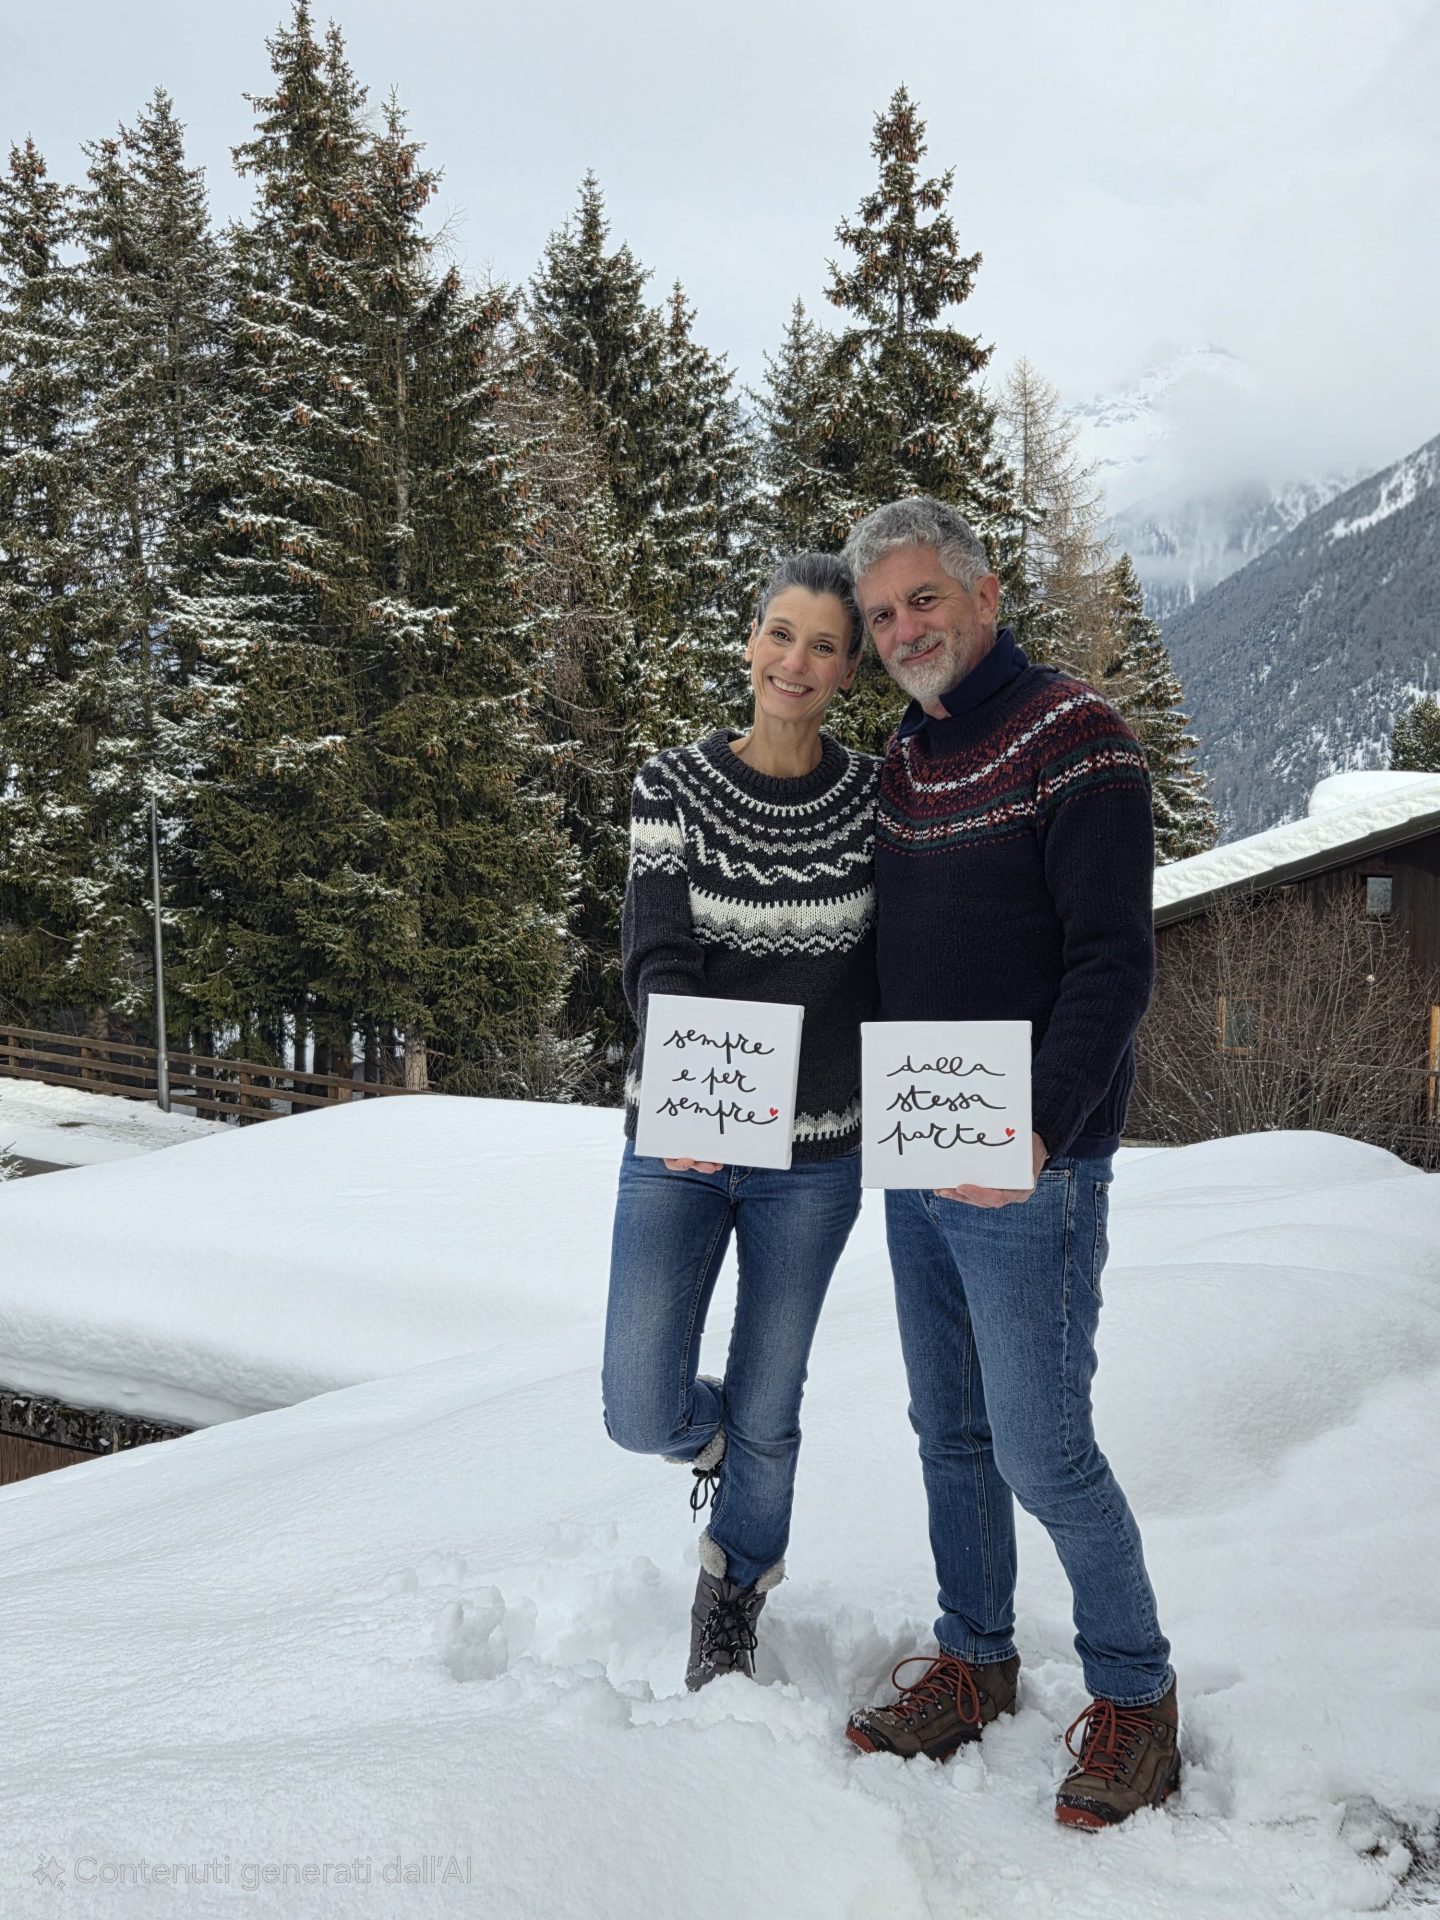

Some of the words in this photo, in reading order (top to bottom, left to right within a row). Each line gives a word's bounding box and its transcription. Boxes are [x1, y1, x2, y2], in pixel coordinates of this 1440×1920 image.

[663, 1028, 775, 1064] sempre
[672, 1068, 697, 1082] e
[701, 1067, 756, 1095] per
[886, 1055, 1006, 1077] dalla
[886, 1085, 1007, 1111] stessa
[656, 1096, 778, 1134] sempre
[877, 1120, 1015, 1155] parte
